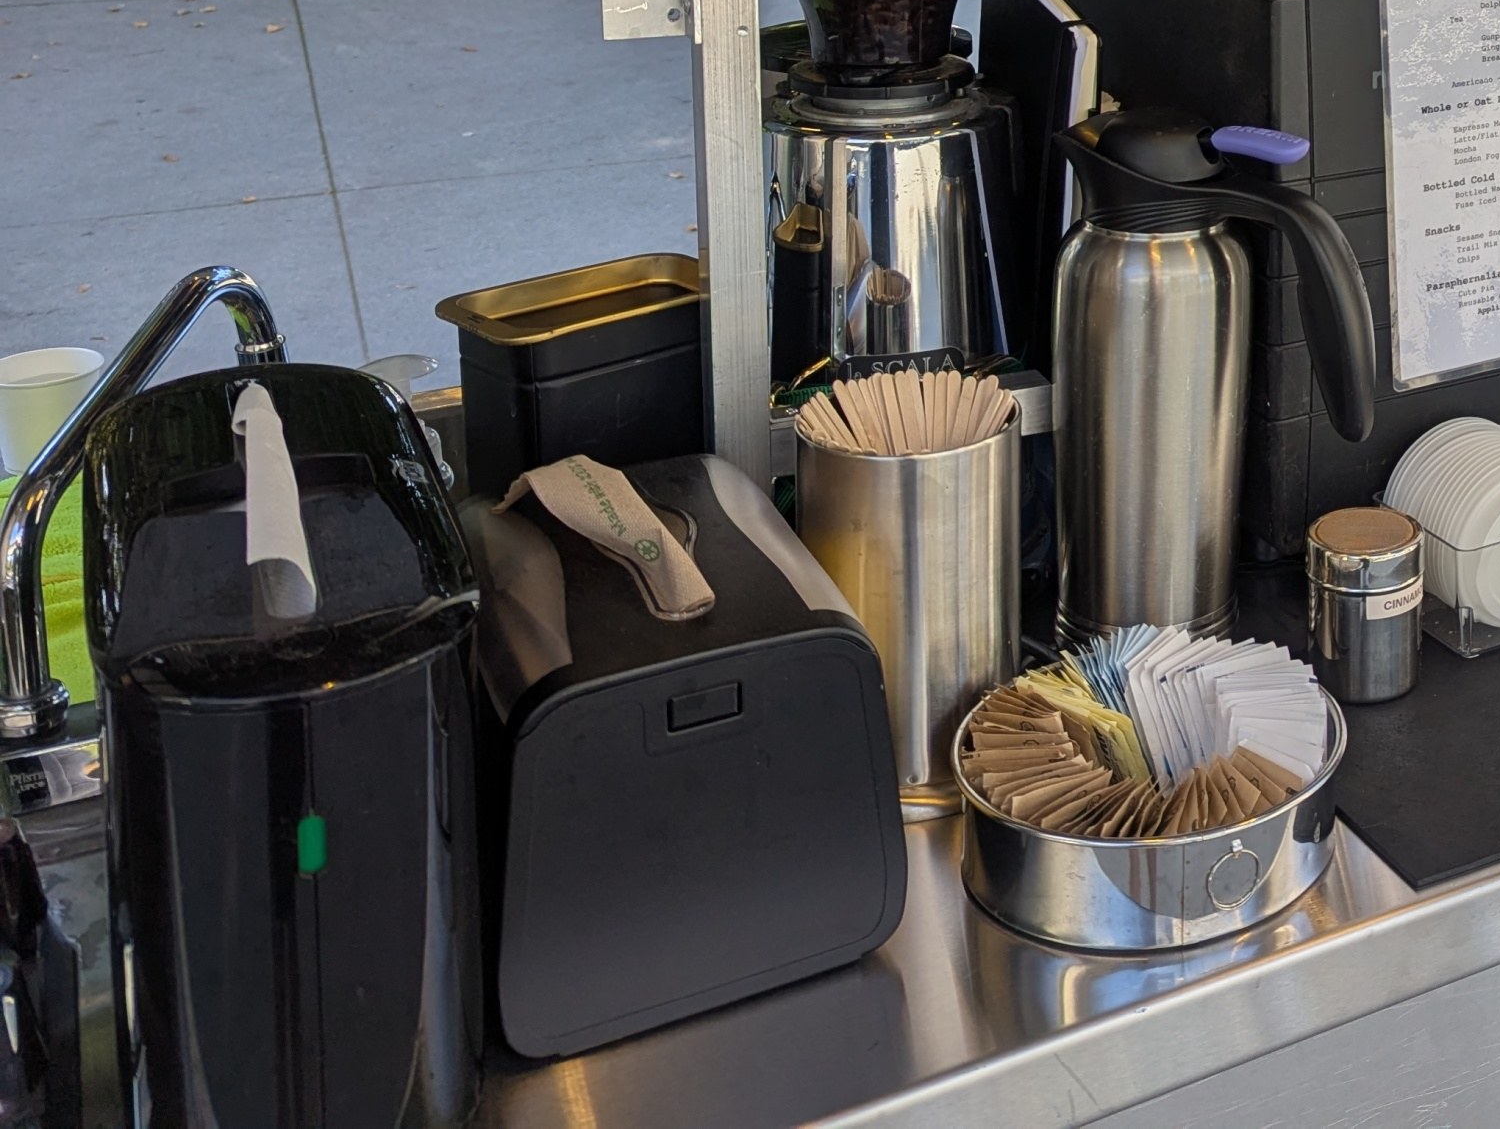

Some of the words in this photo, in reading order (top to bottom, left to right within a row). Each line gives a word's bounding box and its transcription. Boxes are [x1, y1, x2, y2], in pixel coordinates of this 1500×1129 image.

[1451, 77, 1494, 88] Americano
[1421, 103, 1452, 115] Whole
[1457, 101, 1469, 109] or
[1474, 97, 1492, 106] Oat
[1453, 122, 1490, 134] Espresso
[1453, 146, 1477, 154] Mocha
[1454, 155, 1482, 165] London
[1486, 152, 1500, 160] Fog
[1423, 178, 1466, 192] Bottled
[1471, 173, 1495, 184] Cold
[1455, 188, 1488, 198] Bottled
[1455, 201, 1474, 209] Fuse
[1479, 197, 1497, 205] Iced
[1425, 224, 1461, 237] Snacks
[1456, 233, 1484, 243] Sesame
[1457, 244, 1480, 253] Trail
[1484, 241, 1498, 249] Mix
[1457, 255, 1480, 264] Chips
[1458, 289, 1477, 297] Cute
[1458, 296, 1495, 308] Reusable
[871, 353, 957, 382] SCALA
[599, 497, 627, 537] Made
[1384, 585, 1423, 610] CINNAM
